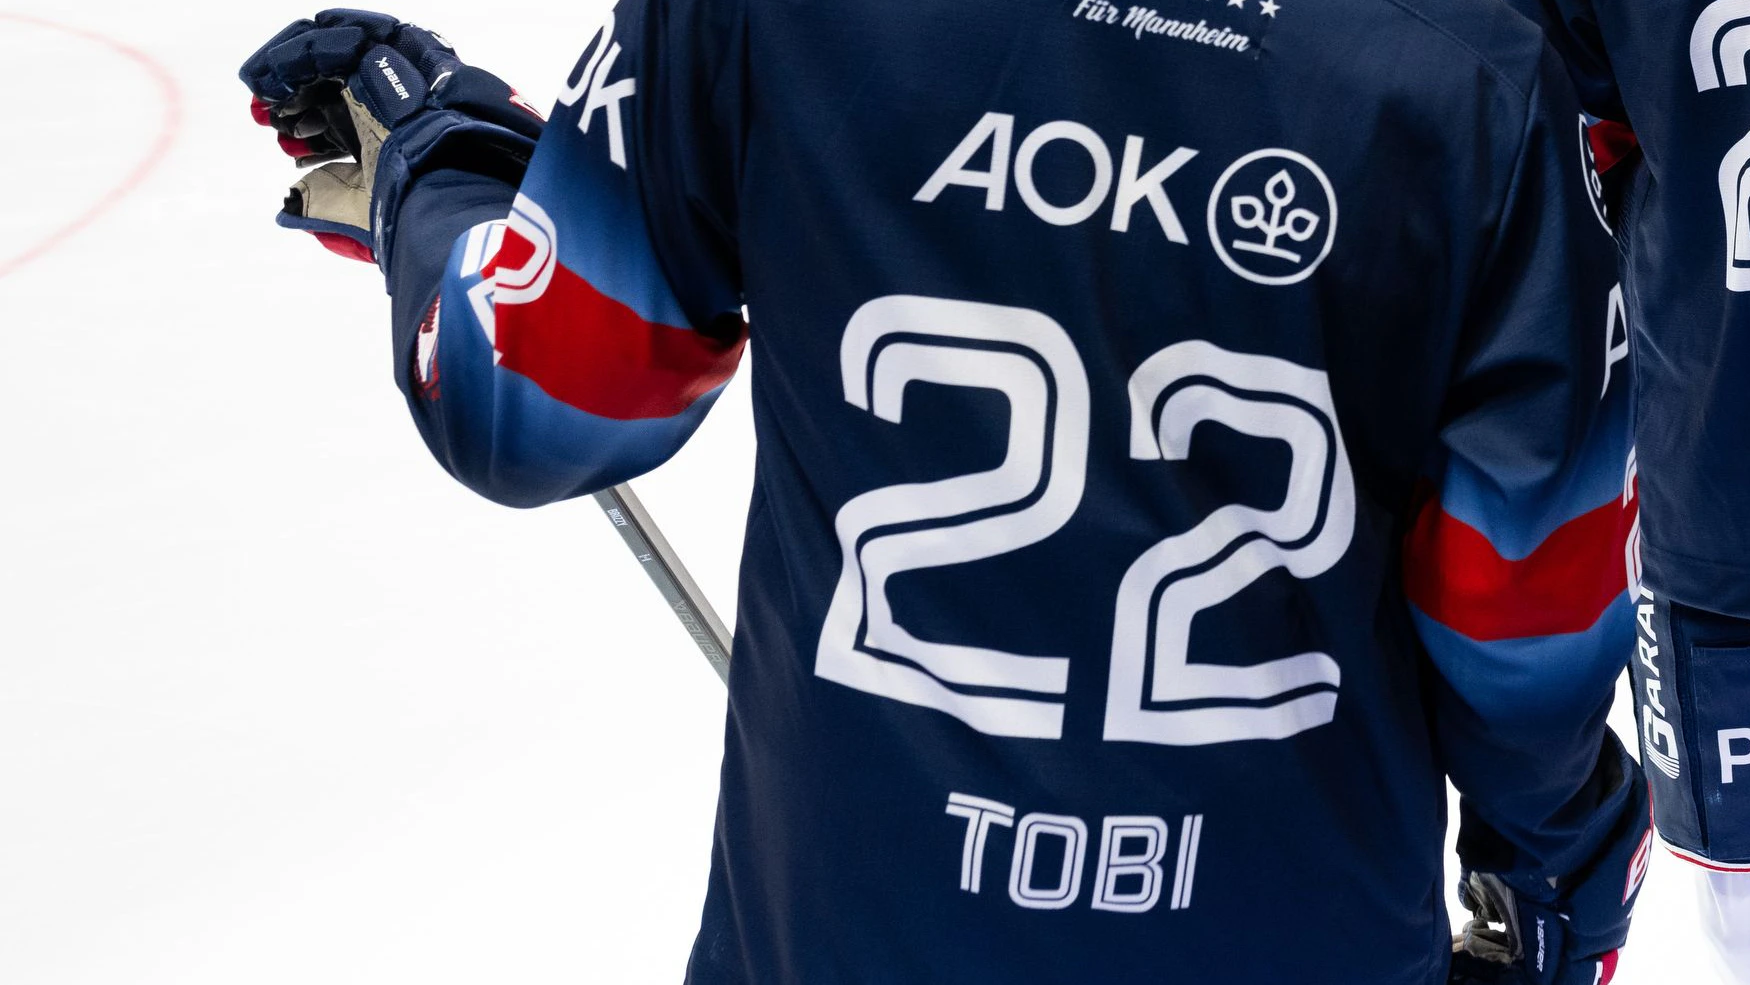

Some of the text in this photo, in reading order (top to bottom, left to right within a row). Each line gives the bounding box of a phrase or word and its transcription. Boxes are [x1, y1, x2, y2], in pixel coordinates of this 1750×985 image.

[1122, 4, 1251, 52] Mannheim
[912, 111, 1200, 245] AOK
[814, 294, 1357, 746] 22
[945, 791, 1204, 914] TOBI
